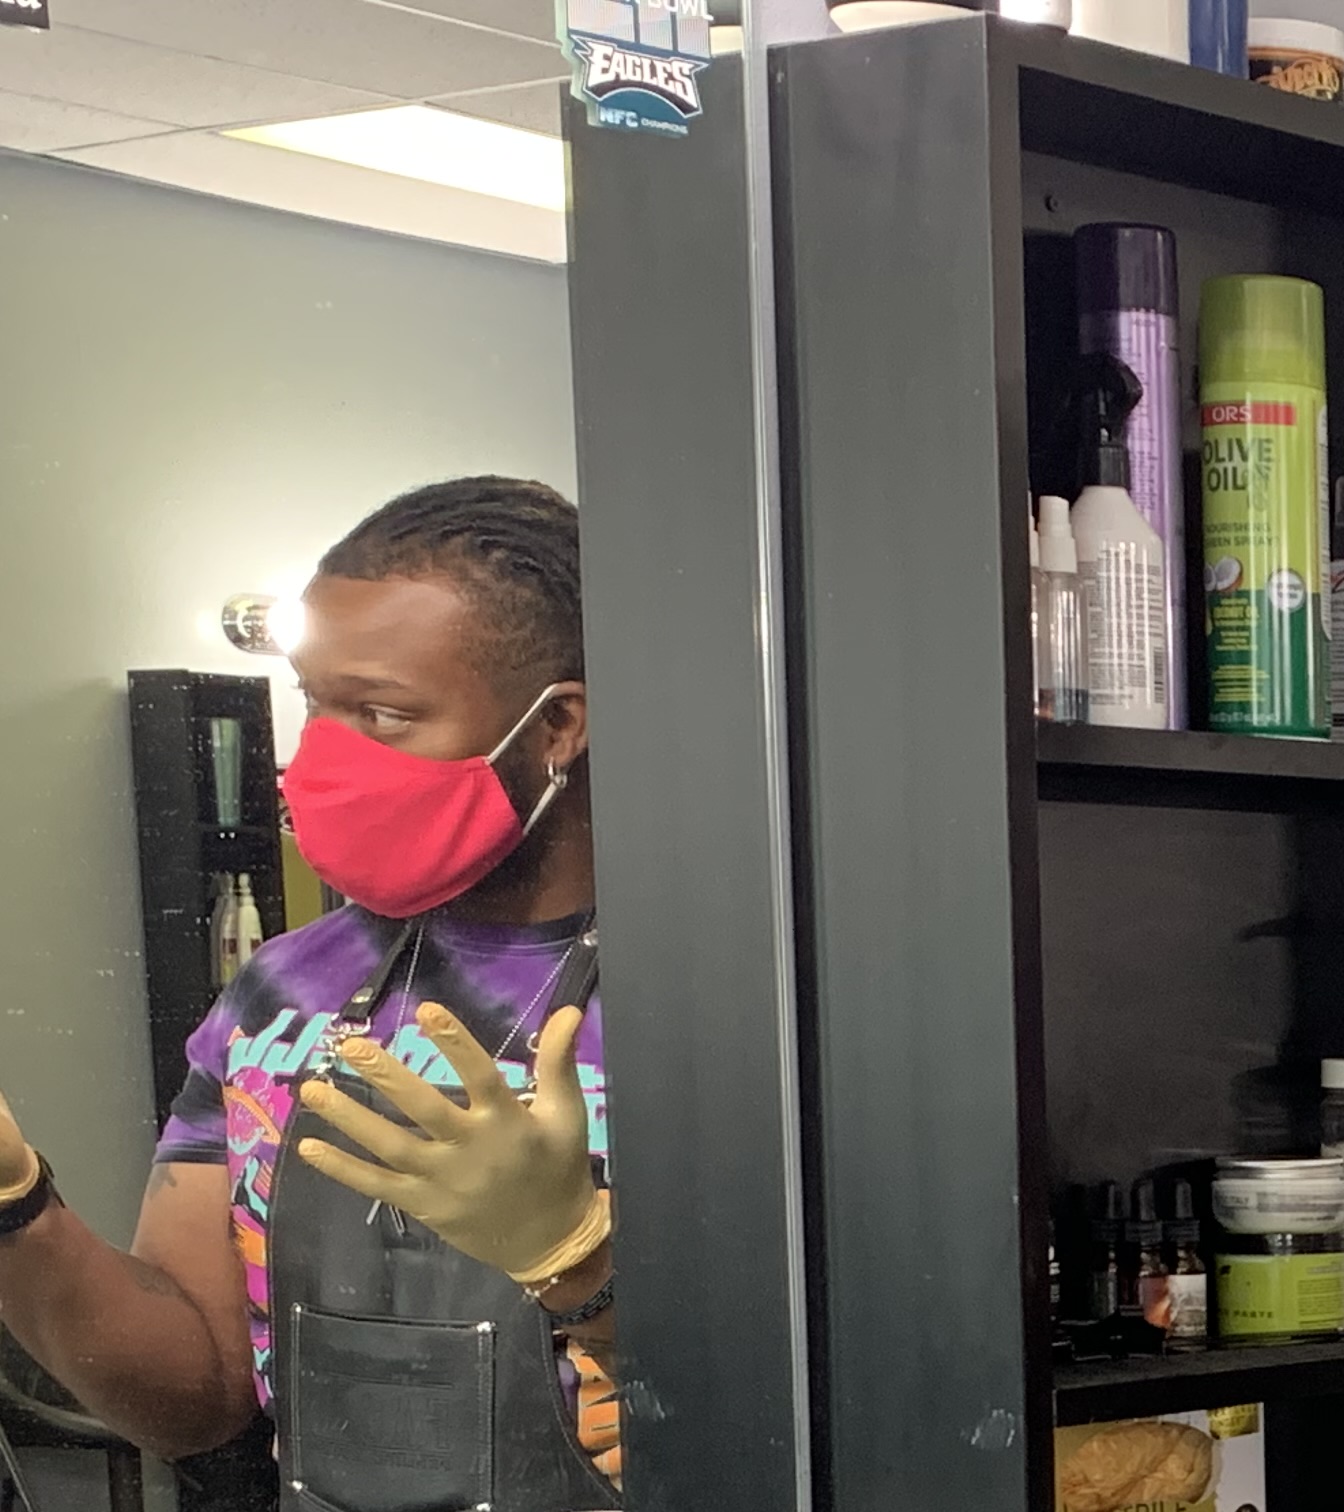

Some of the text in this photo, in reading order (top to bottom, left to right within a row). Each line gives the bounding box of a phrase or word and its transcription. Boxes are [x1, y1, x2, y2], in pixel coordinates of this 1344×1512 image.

[587, 41, 698, 108] EAGLES
[600, 107, 638, 128] NFC
[1212, 405, 1250, 422] ORS
[1202, 438, 1273, 464] OLIVE
[1207, 467, 1246, 492] OIL
